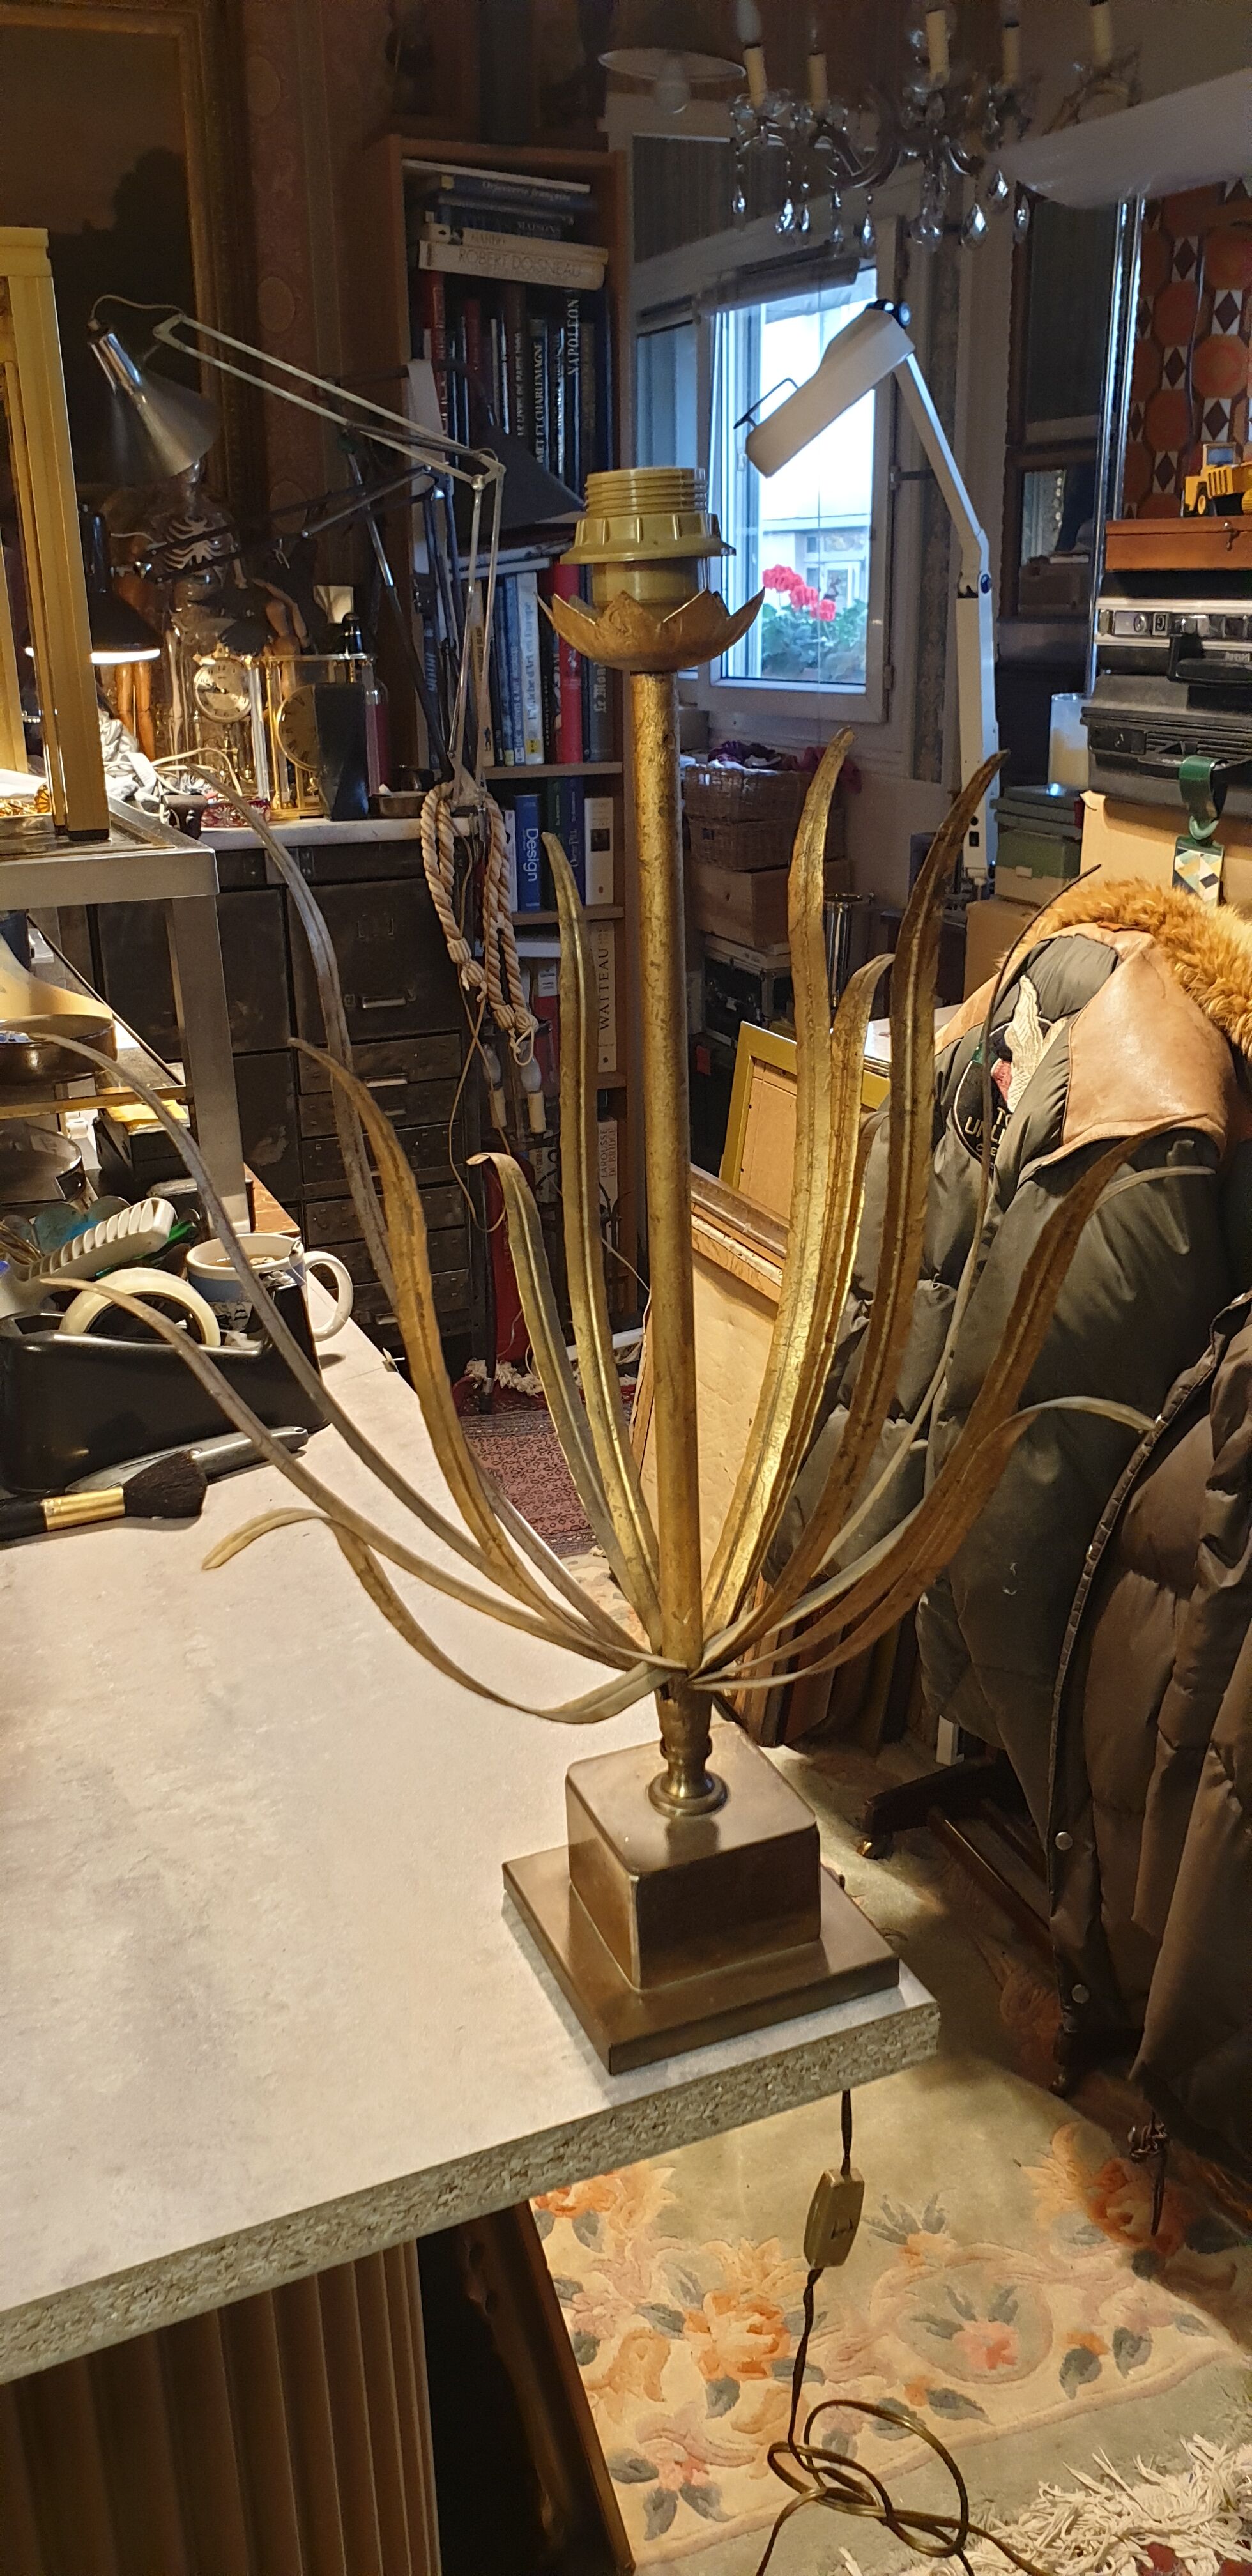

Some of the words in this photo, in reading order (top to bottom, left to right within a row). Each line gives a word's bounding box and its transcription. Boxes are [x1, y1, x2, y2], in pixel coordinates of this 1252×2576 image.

[458, 249, 507, 267] ROBERT
[567, 298, 579, 375] NAPOLEON
[523, 828, 539, 882] Design
[598, 948, 609, 1030] WATTEAU
[600, 1129, 608, 1178] LAROUSSE
[607, 1127, 616, 1162] BRIDGE
